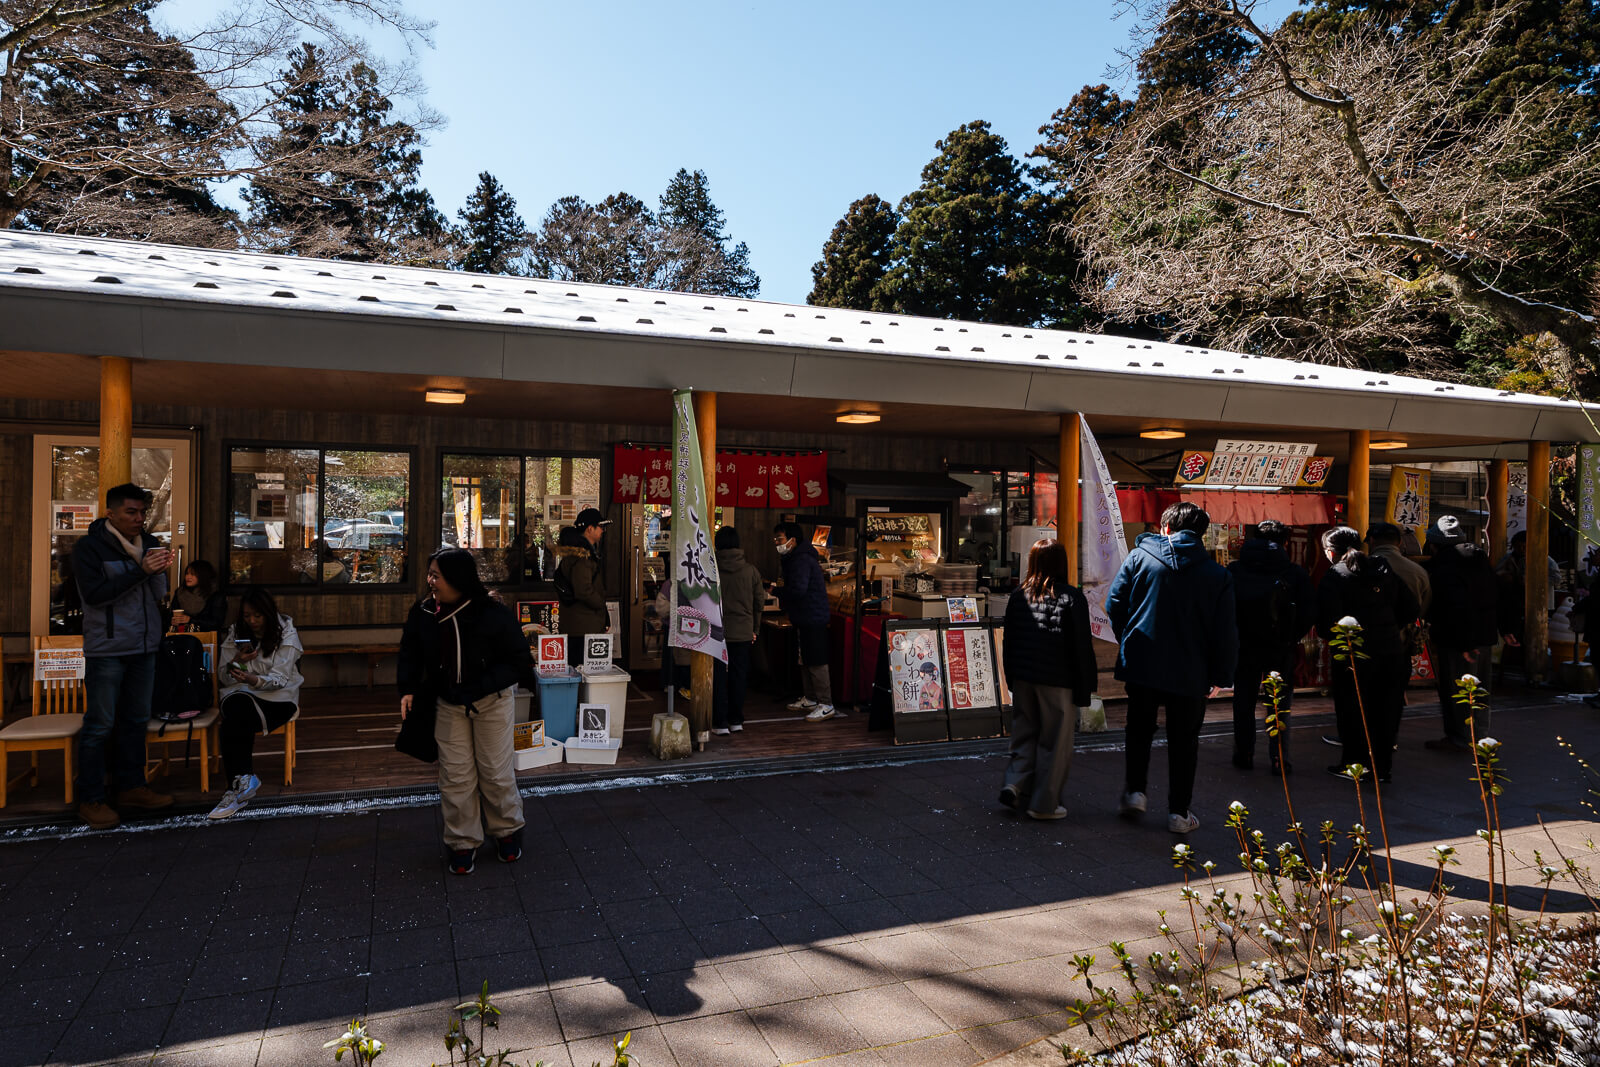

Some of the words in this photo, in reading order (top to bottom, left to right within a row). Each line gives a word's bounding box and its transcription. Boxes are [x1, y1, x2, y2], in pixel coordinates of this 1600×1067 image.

[1225, 442, 1308, 455] テイクアウト専用
[757, 463, 794, 476] お休処
[1183, 453, 1206, 478] 幸
[1304, 458, 1327, 483] 福
